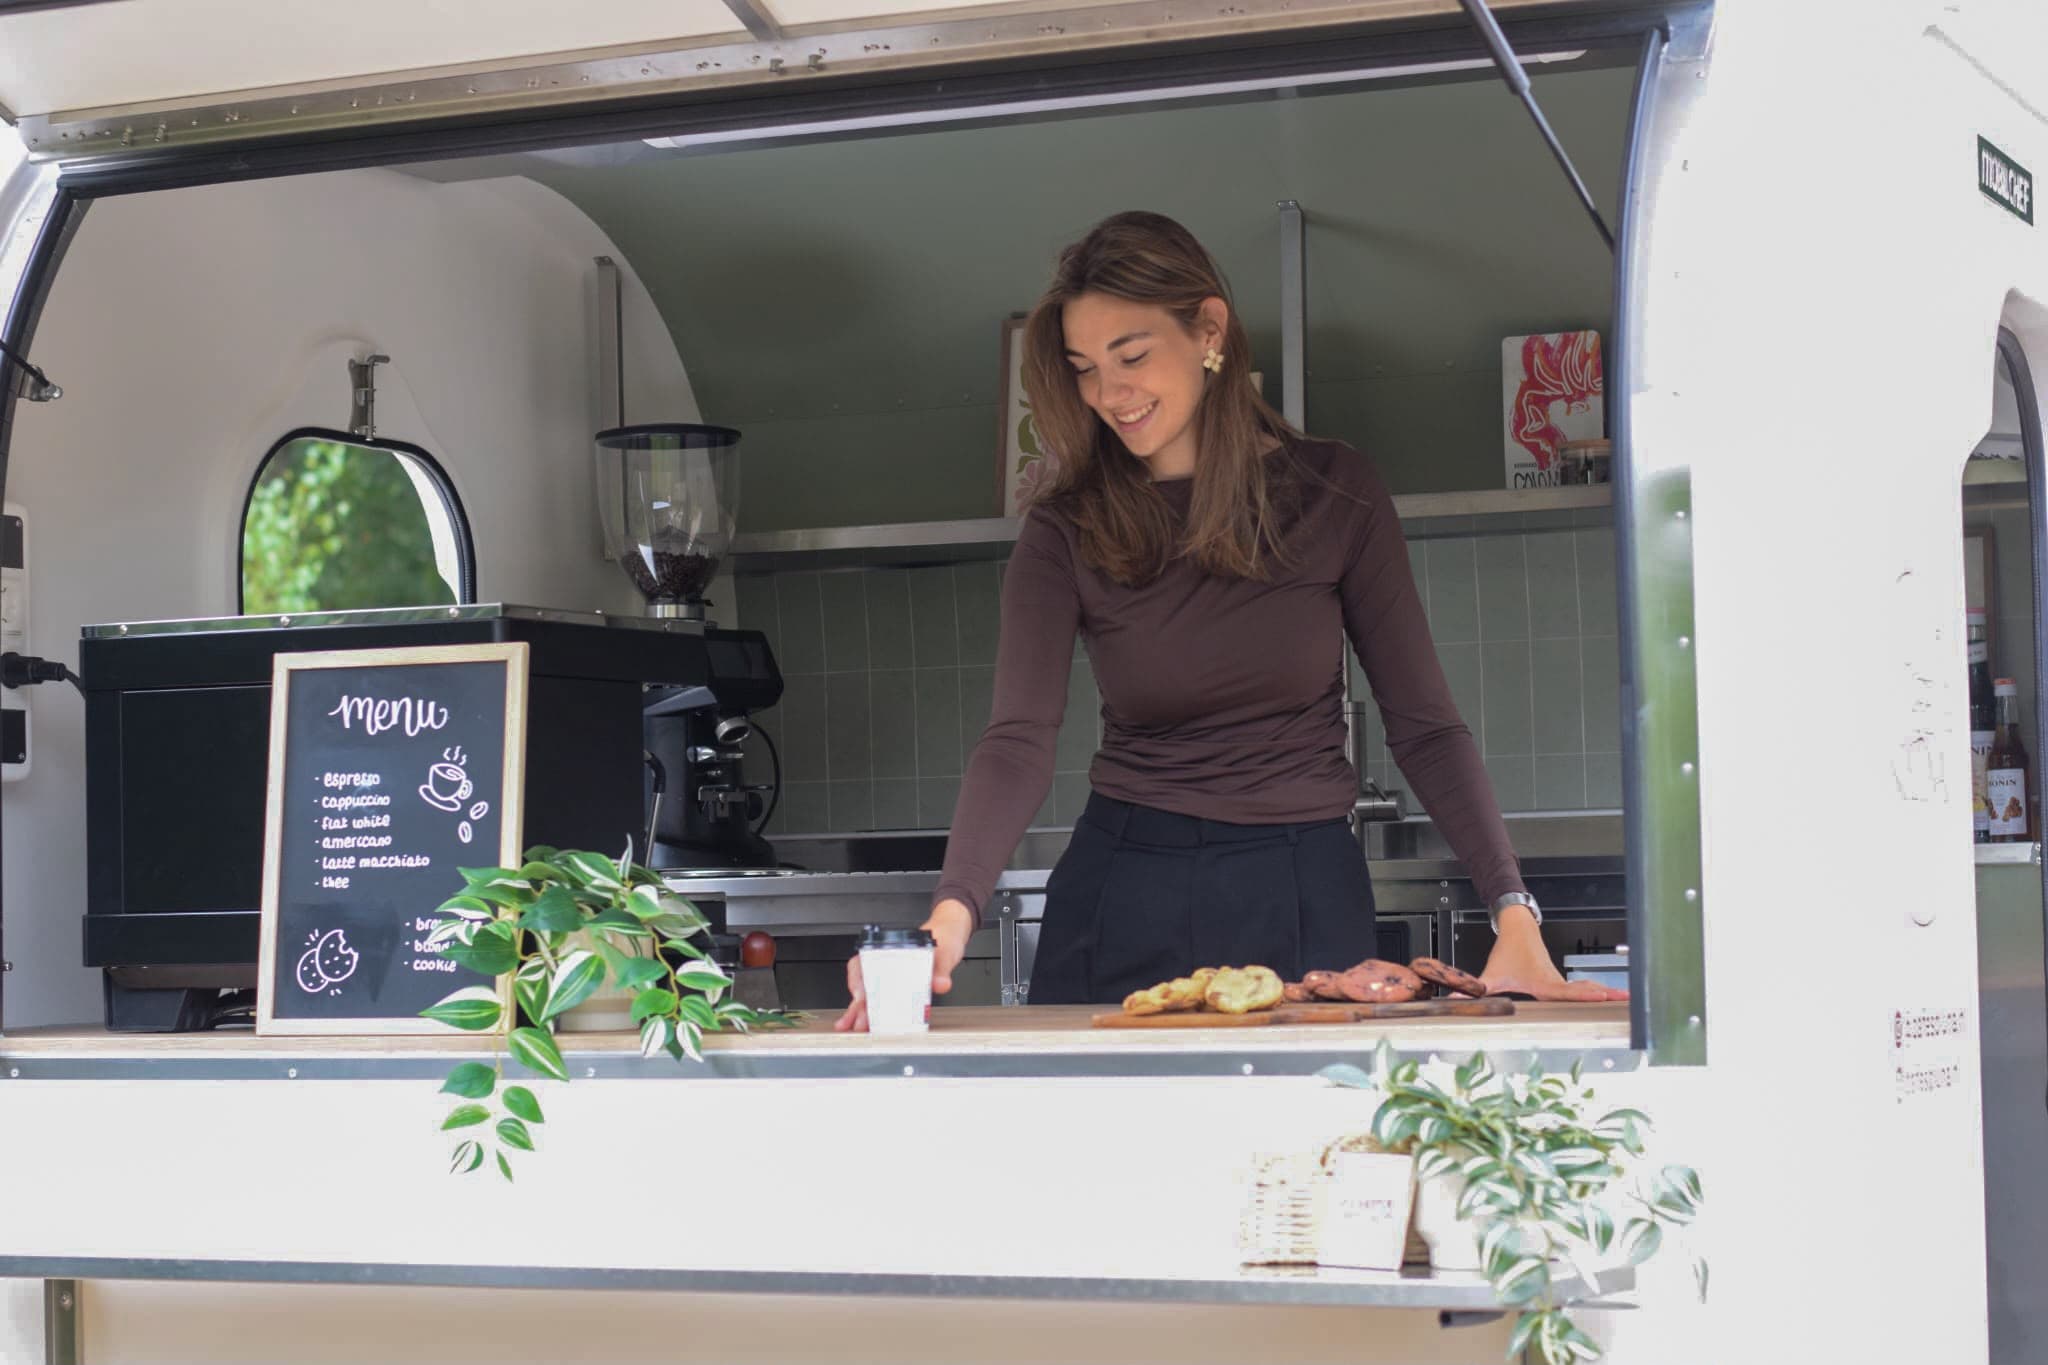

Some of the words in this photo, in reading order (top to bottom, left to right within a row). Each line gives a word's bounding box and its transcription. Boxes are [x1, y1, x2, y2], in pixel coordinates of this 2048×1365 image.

[327, 695, 449, 736] menu
[324, 772, 381, 790] espresso
[322, 795, 391, 811] cappuccino
[322, 816, 349, 830] flat
[352, 814, 391, 829] white
[322, 836, 392, 848] americano
[322, 856, 356, 870] latte
[359, 854, 430, 868] macchiato
[322, 876, 350, 888] thee
[413, 959, 457, 972] cookie
